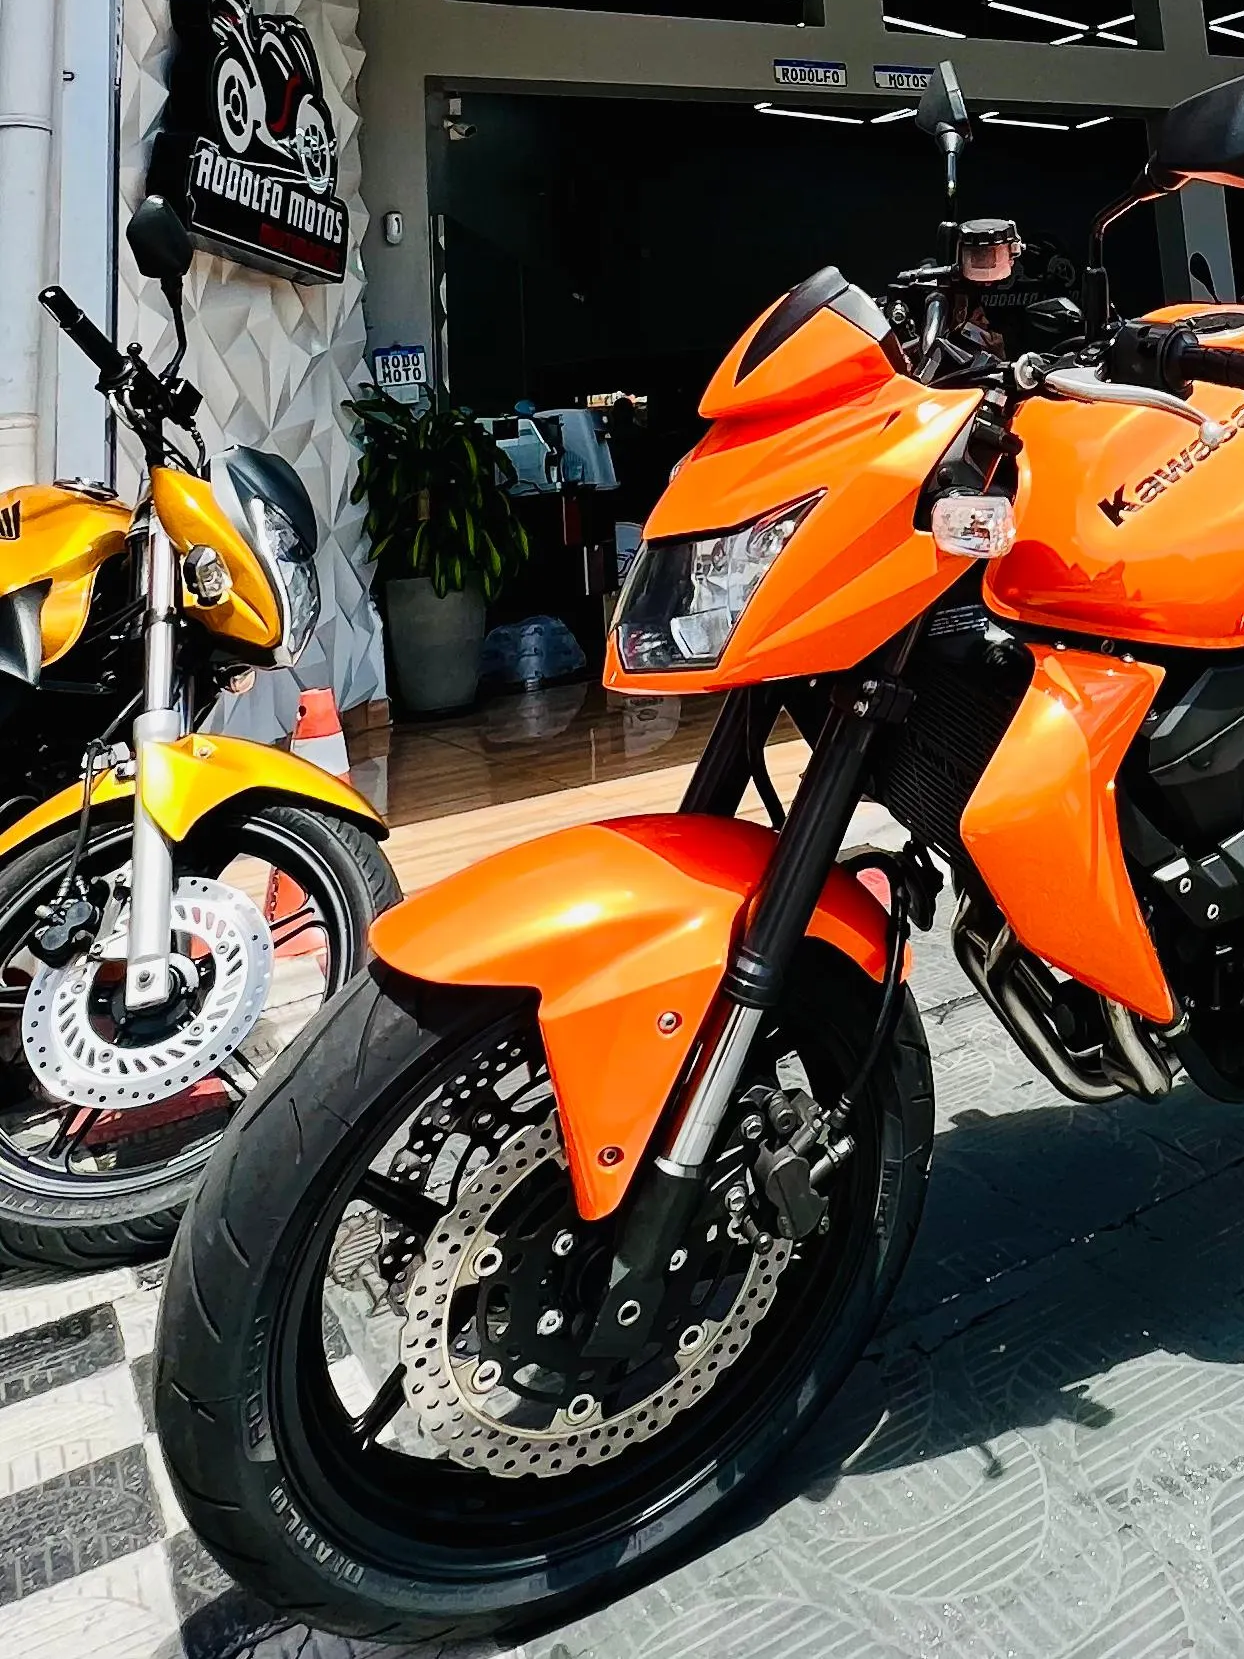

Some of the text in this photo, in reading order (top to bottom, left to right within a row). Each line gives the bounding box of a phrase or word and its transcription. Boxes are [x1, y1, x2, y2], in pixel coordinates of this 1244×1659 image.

[781, 66, 928, 88] RODOLFO MOTOS
[196, 148, 343, 244] RODOLFO MOTOS
[381, 354, 420, 370] RODO
[382, 368, 422, 383] MOTO
